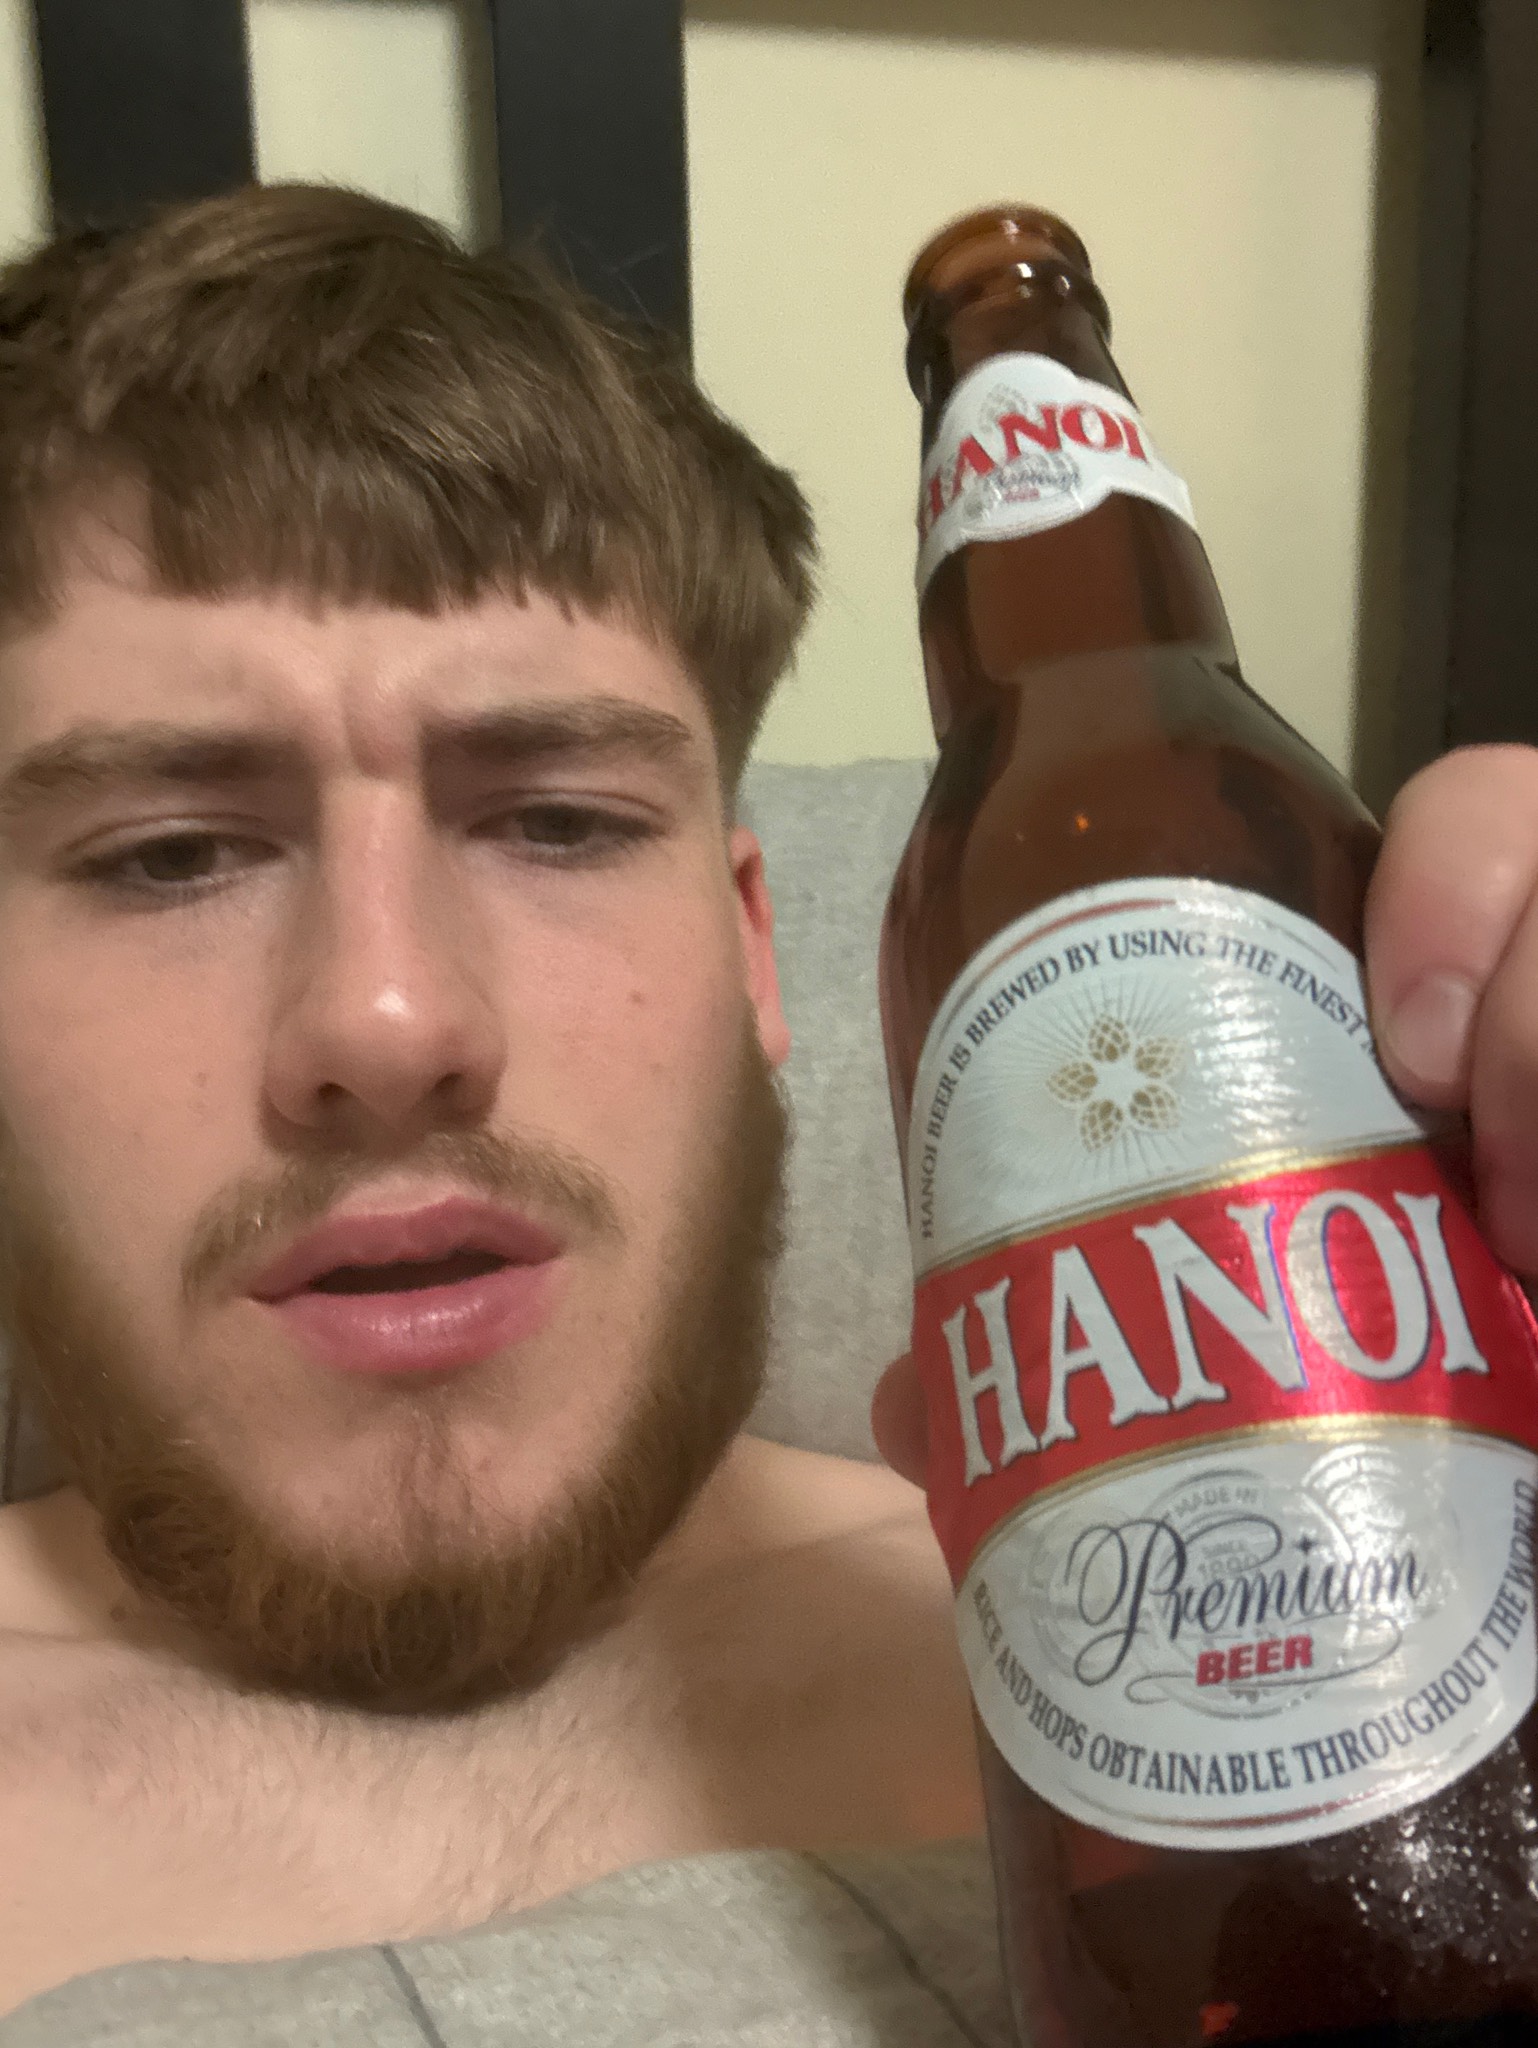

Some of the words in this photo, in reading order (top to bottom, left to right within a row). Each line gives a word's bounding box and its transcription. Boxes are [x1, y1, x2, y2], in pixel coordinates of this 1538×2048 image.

[1064, 939, 1100, 974] BY
[1108, 928, 1207, 961] USING
[1216, 934, 1278, 976] THE
[965, 956, 1061, 1046] BREWED
[1278, 960, 1367, 1037] FINEST
[949, 1042, 972, 1073] IS
[927, 1071, 959, 1140] BEER
[920, 1144, 938, 1240] HANOI
[941, 1189, 1491, 1488] HANOI
[1503, 1476, 1537, 1592] WORLD
[1066, 1513, 1427, 1687] Premium
[1480, 1582, 1528, 1652] THE
[995, 1644, 1033, 1707] AND
[1195, 1633, 1315, 1687] BEER
[1028, 1687, 1089, 1760] HOPS
[1296, 1635, 1499, 1785] THROUGHOUT
[1089, 1732, 1291, 1797] OBTAINABLE
